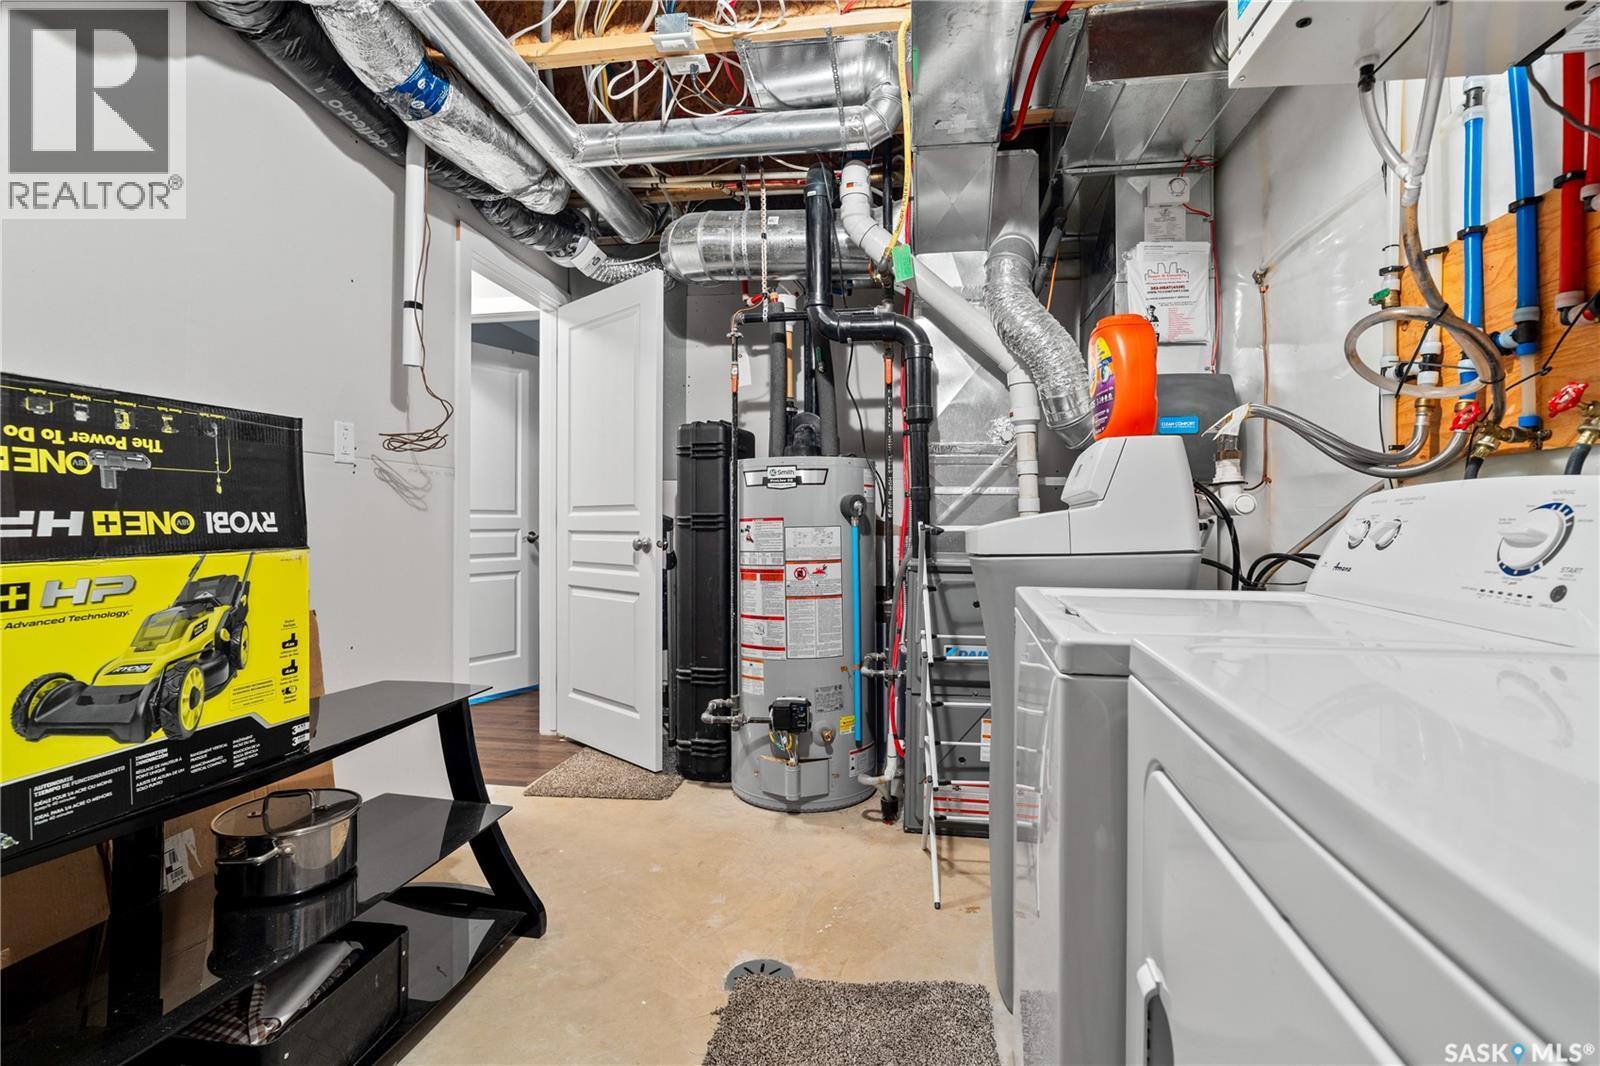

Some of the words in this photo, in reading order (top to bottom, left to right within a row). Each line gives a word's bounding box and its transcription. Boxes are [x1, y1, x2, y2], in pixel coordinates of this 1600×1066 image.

[3, 424, 36, 442] Do
[41, 428, 65, 445] To
[69, 432, 128, 450] Power
[132, 437, 164, 453] The
[204, 511, 278, 534] RYOBI
[1332, 562, 1352, 572] Amana
[41, 575, 137, 608] HP
[4, 616, 66, 630] Advanced
[34, 784, 61, 798] TIEMPO
[71, 765, 126, 786] FUNCIONAMIENTO
[34, 776, 74, 792] AUTONOMIE
[52, 794, 66, 802] POUR
[74, 787, 87, 796] ACRE
[96, 778, 113, 788] MOINS
[50, 808, 64, 816] PARA
[72, 800, 86, 808] ACRE
